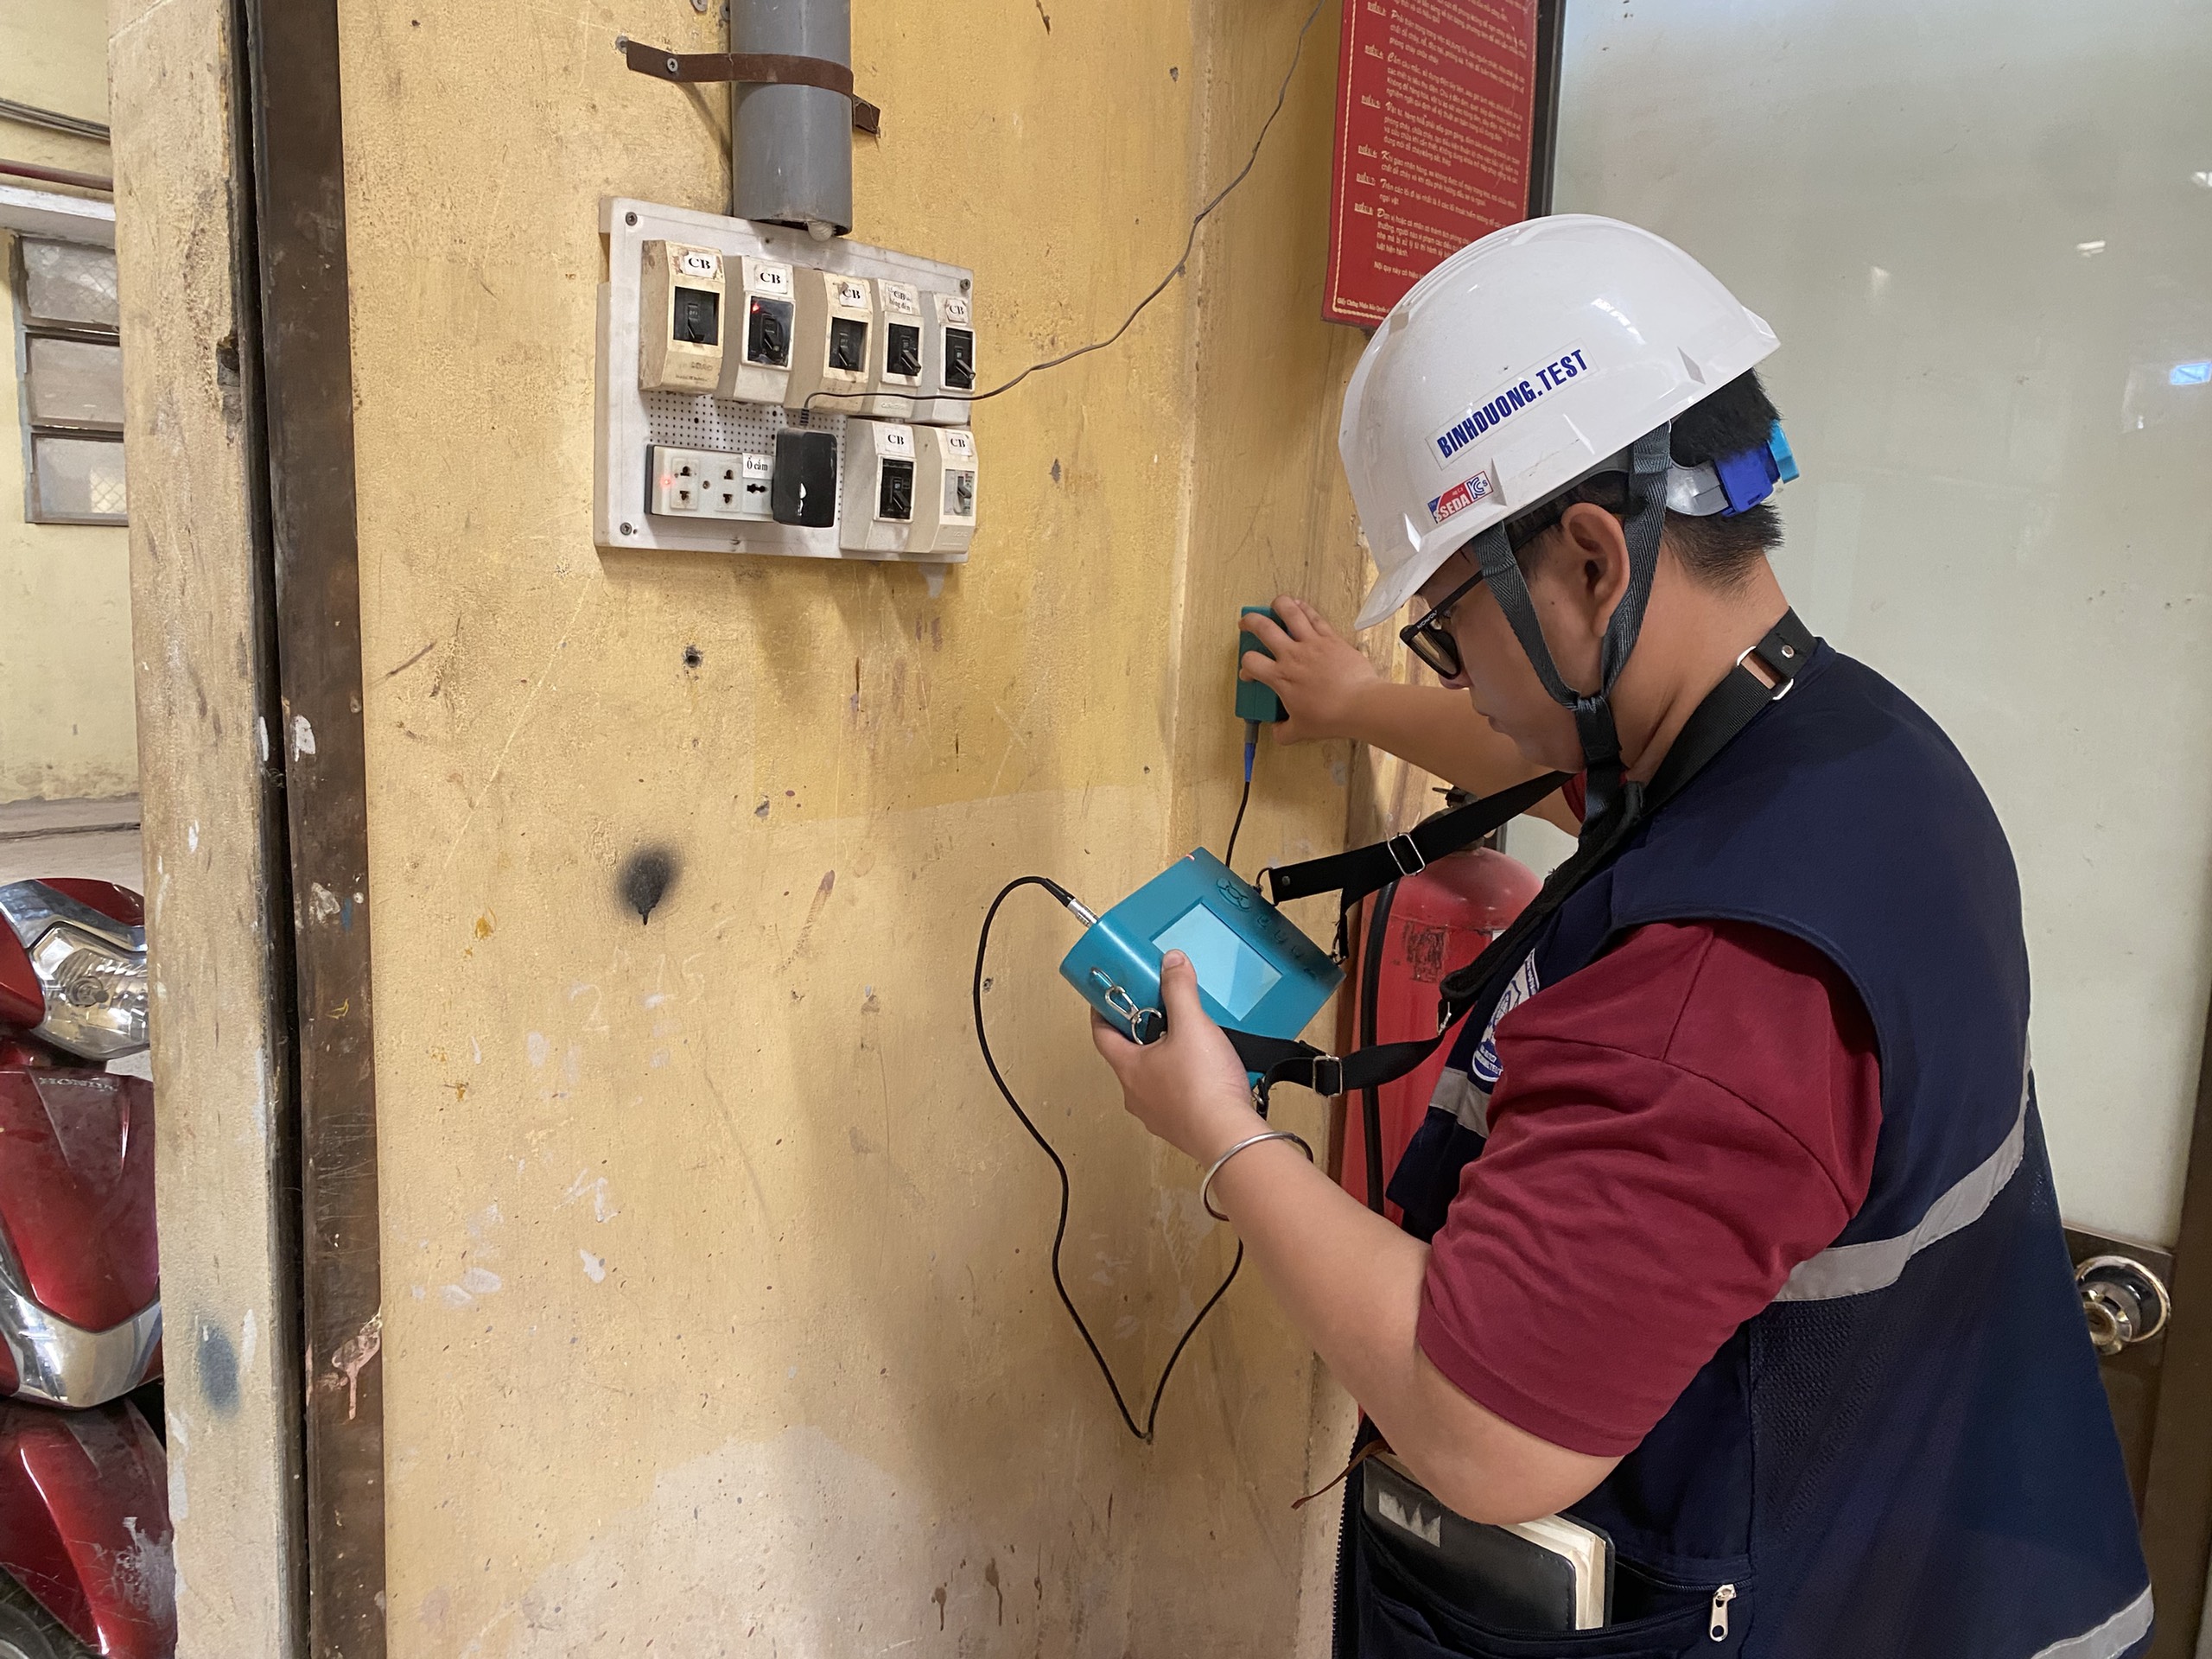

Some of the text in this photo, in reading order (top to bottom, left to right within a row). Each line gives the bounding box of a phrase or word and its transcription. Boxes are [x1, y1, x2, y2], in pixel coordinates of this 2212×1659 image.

[689, 257, 710, 270] CB
[760, 272, 781, 284] CB
[842, 289, 861, 299] CB
[949, 305, 964, 315] CB
[1437, 349, 1587, 458] BINHDUONG.TEST
[887, 434, 905, 445] CB
[950, 438, 966, 448] CB
[754, 459, 768, 471] cắm
[38, 1077, 118, 1092] HONDA
